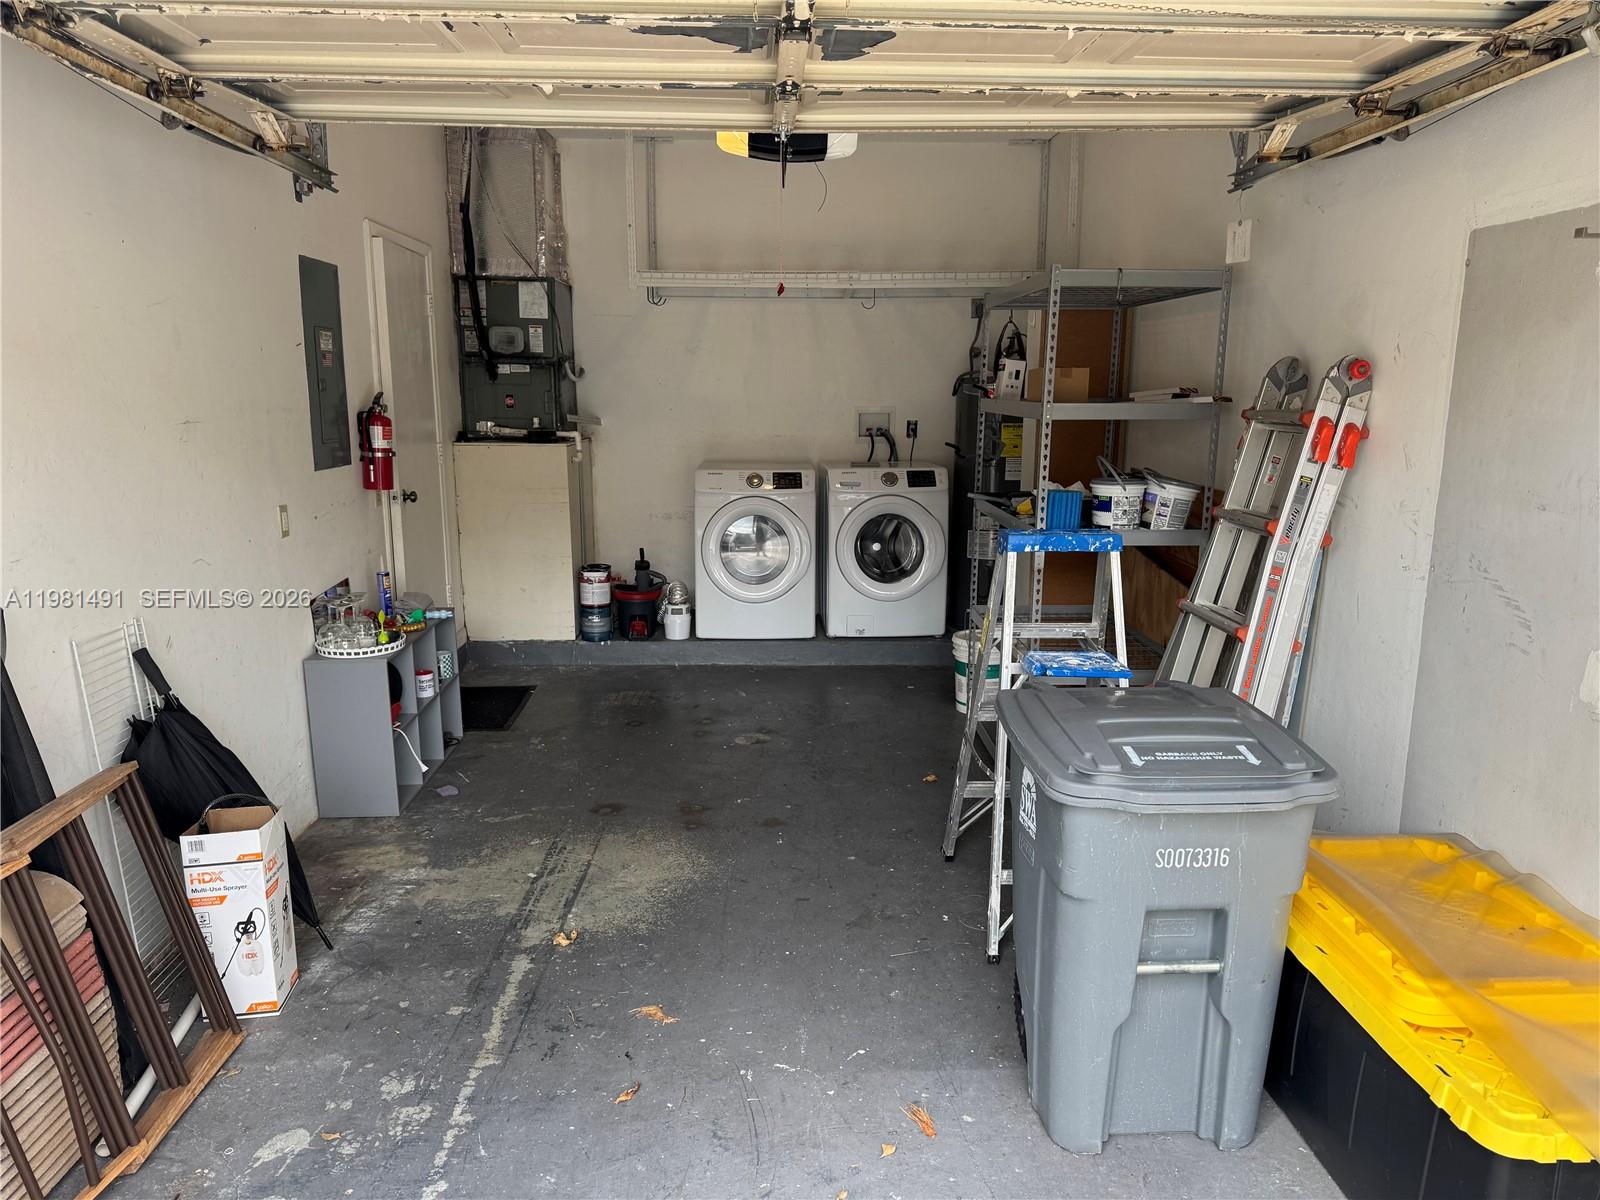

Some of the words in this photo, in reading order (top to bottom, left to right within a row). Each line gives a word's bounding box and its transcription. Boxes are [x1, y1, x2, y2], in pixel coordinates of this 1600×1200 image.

[1279, 507, 1300, 545] Velocity
[1154, 847, 1231, 868] S0073316
[189, 870, 225, 886] HDX
[191, 886, 222, 894] Multi-Use
[223, 884, 247, 892] Sprayer
